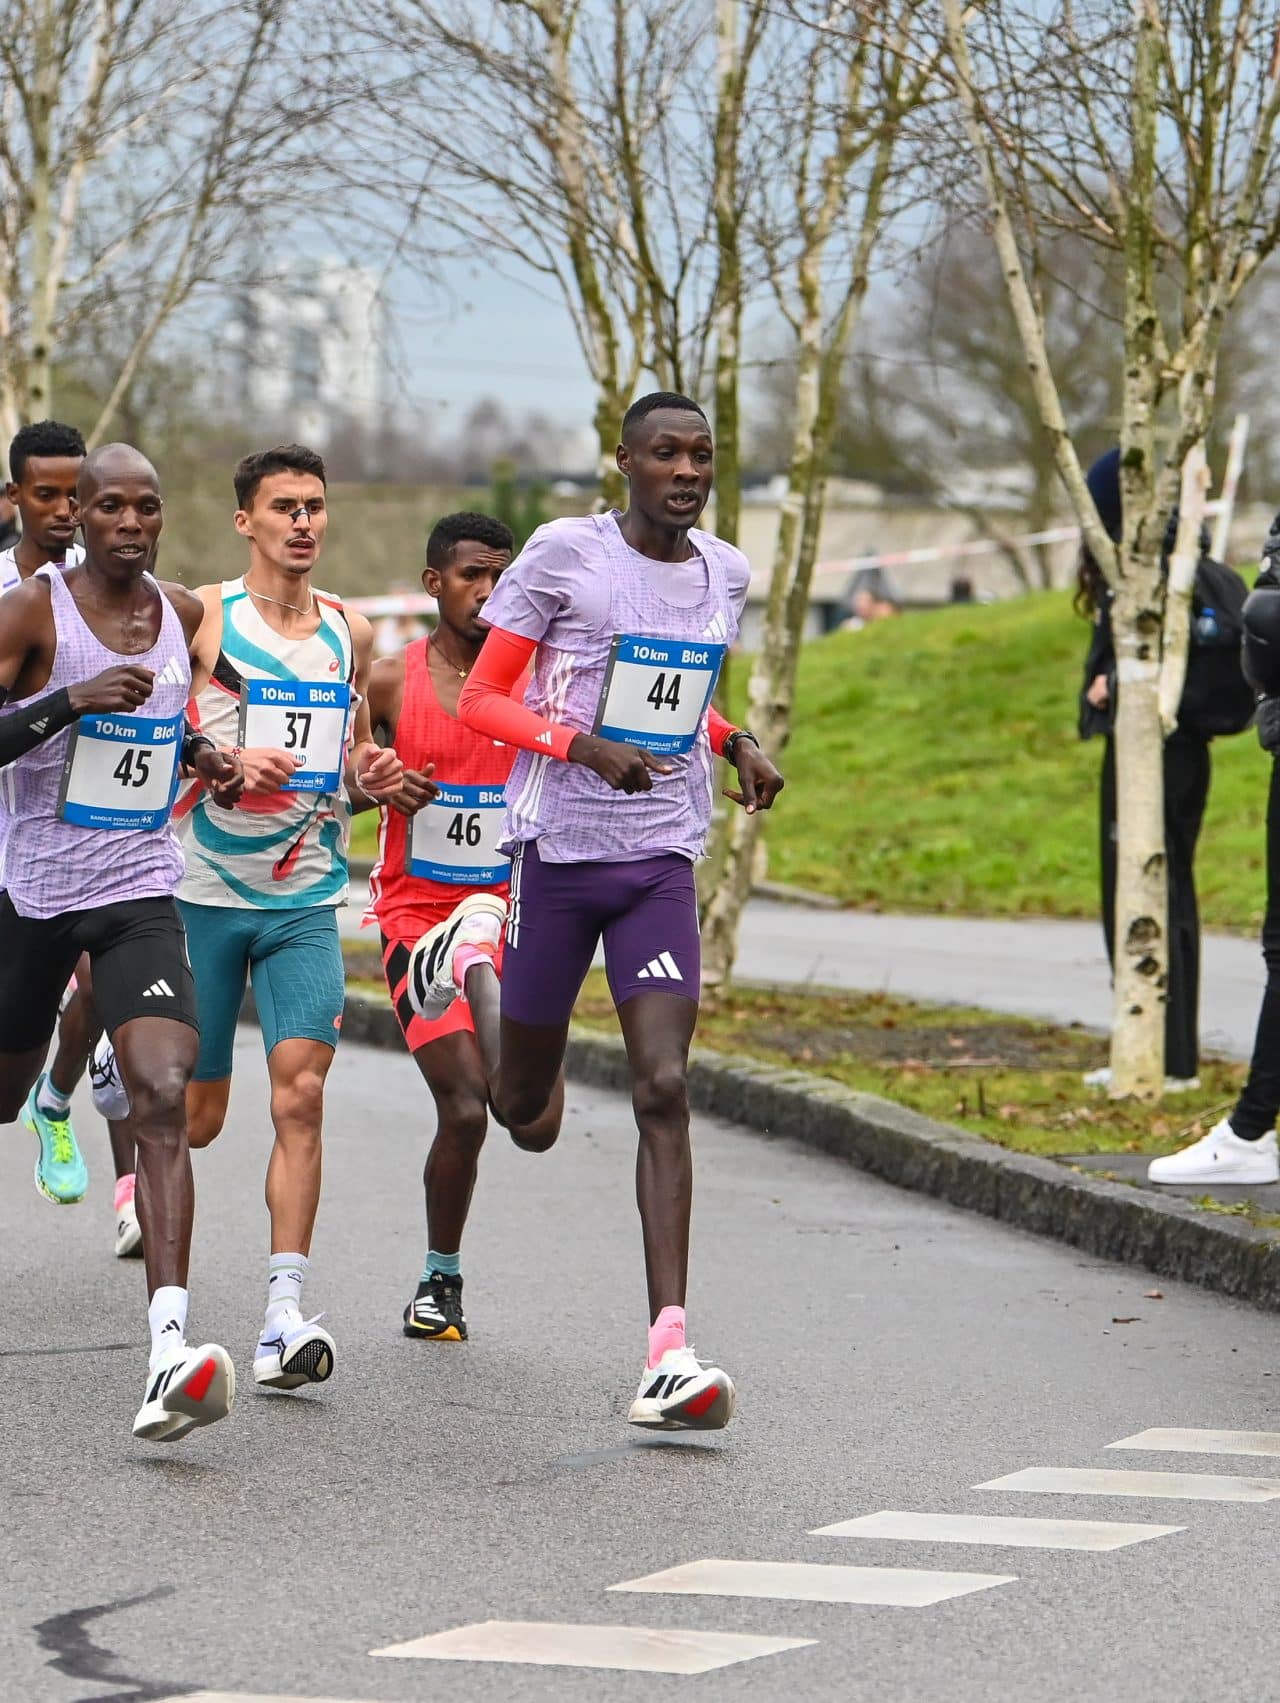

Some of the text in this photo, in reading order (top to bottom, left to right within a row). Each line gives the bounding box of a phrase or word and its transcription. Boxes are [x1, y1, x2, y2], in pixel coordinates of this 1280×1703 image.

[681, 649, 709, 665] Blot
[309, 689, 336, 703] Blot
[647, 672, 682, 711] 44
[152, 725, 175, 740] Blot
[284, 712, 312, 749] 37
[113, 749, 152, 787] 45
[435, 790, 504, 804] 0km Blo
[90, 815, 112, 823] BANQUE
[446, 812, 481, 847] 46
